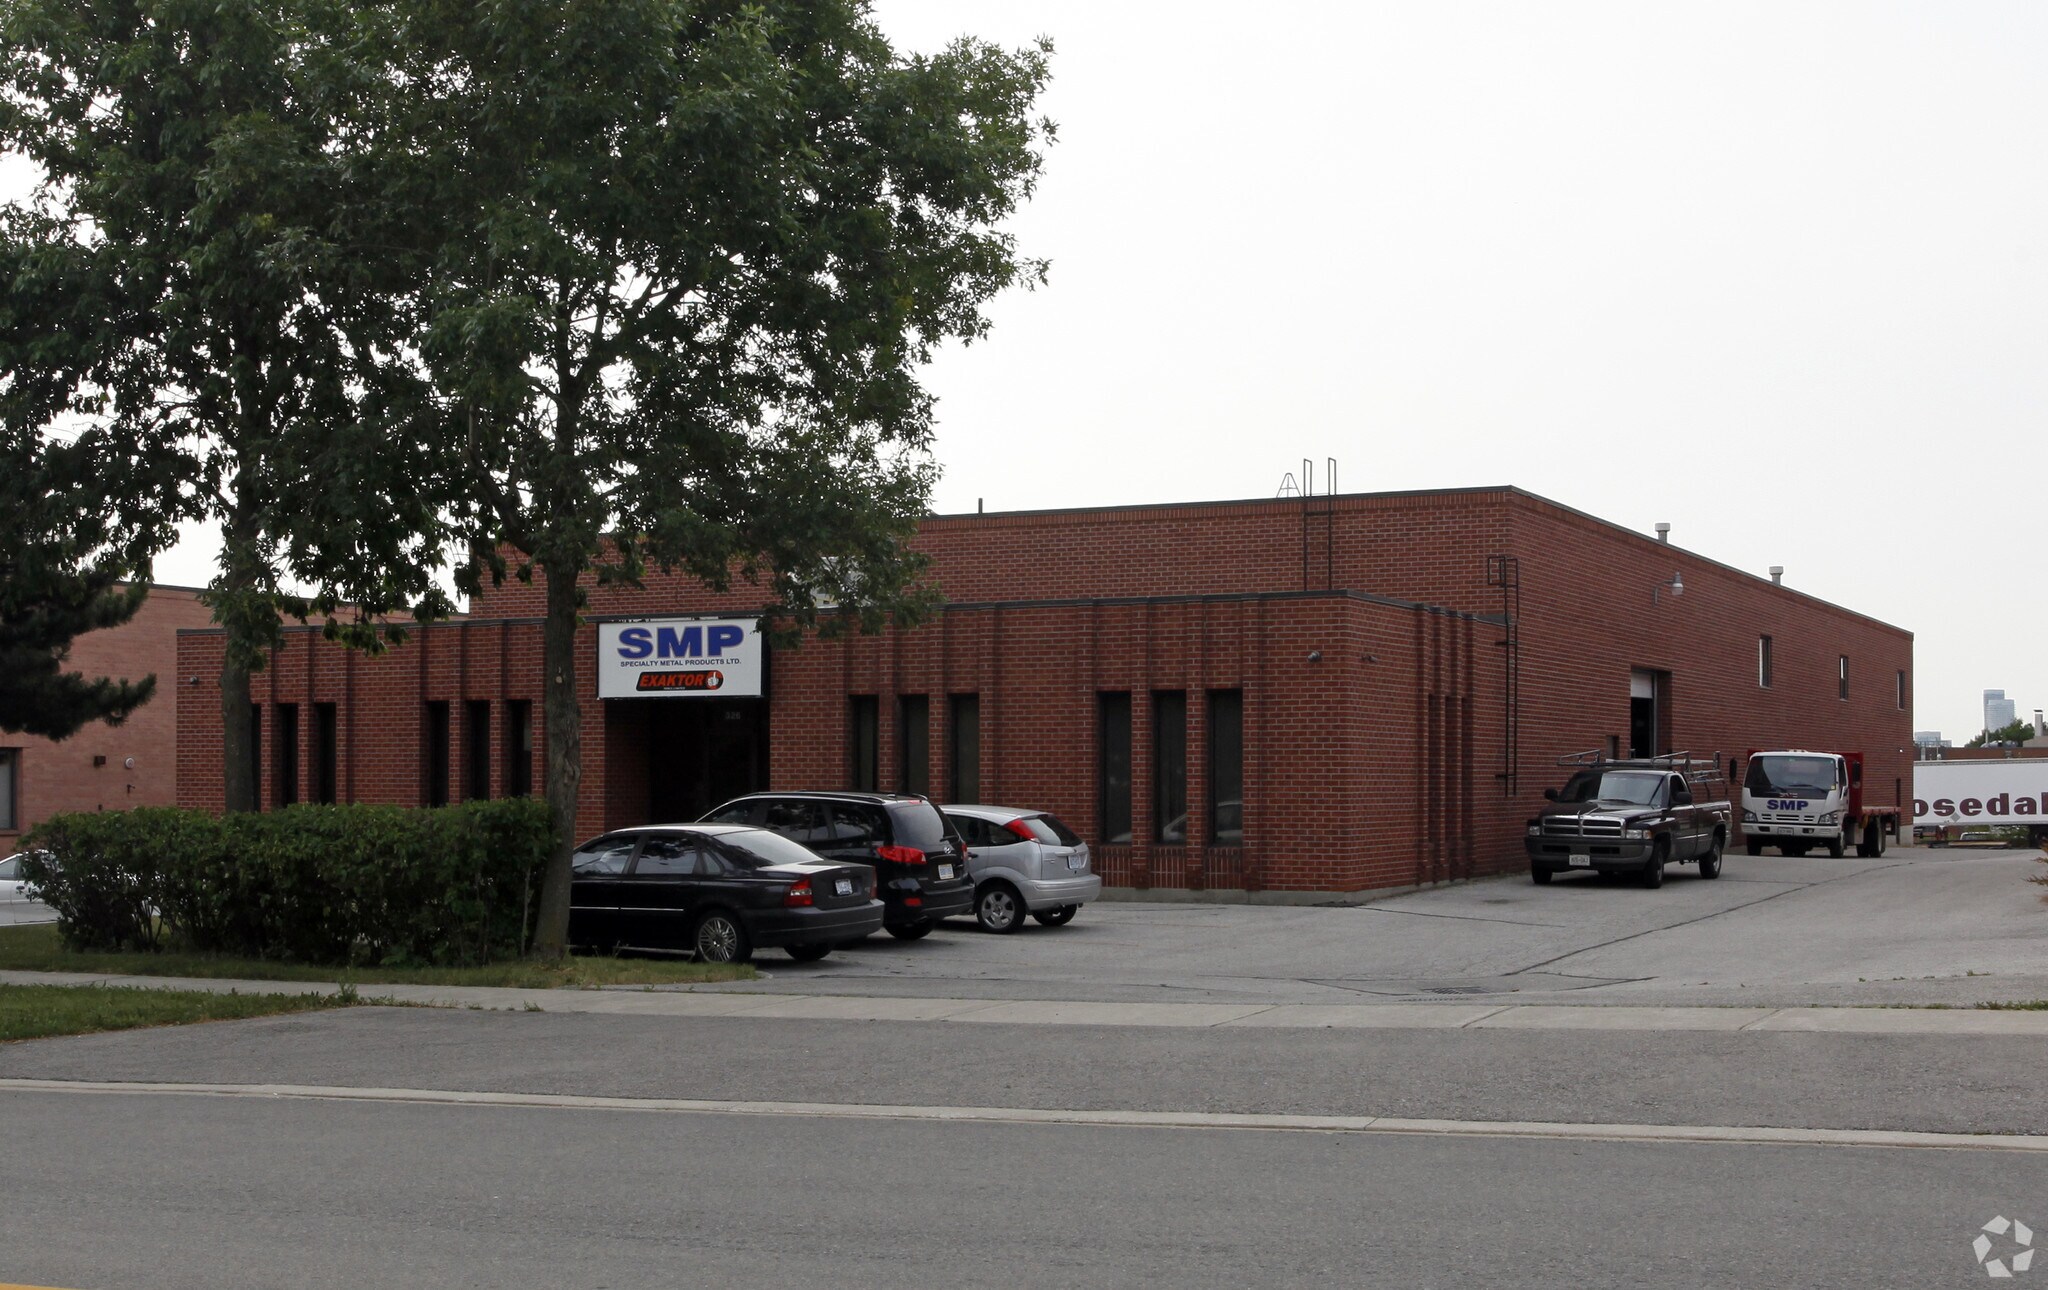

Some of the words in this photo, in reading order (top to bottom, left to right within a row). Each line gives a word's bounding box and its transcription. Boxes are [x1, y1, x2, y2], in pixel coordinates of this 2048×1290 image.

[617, 625, 744, 660] SMP
[640, 673, 703, 687] EXAKTOR
[1767, 799, 1809, 811] SMP
